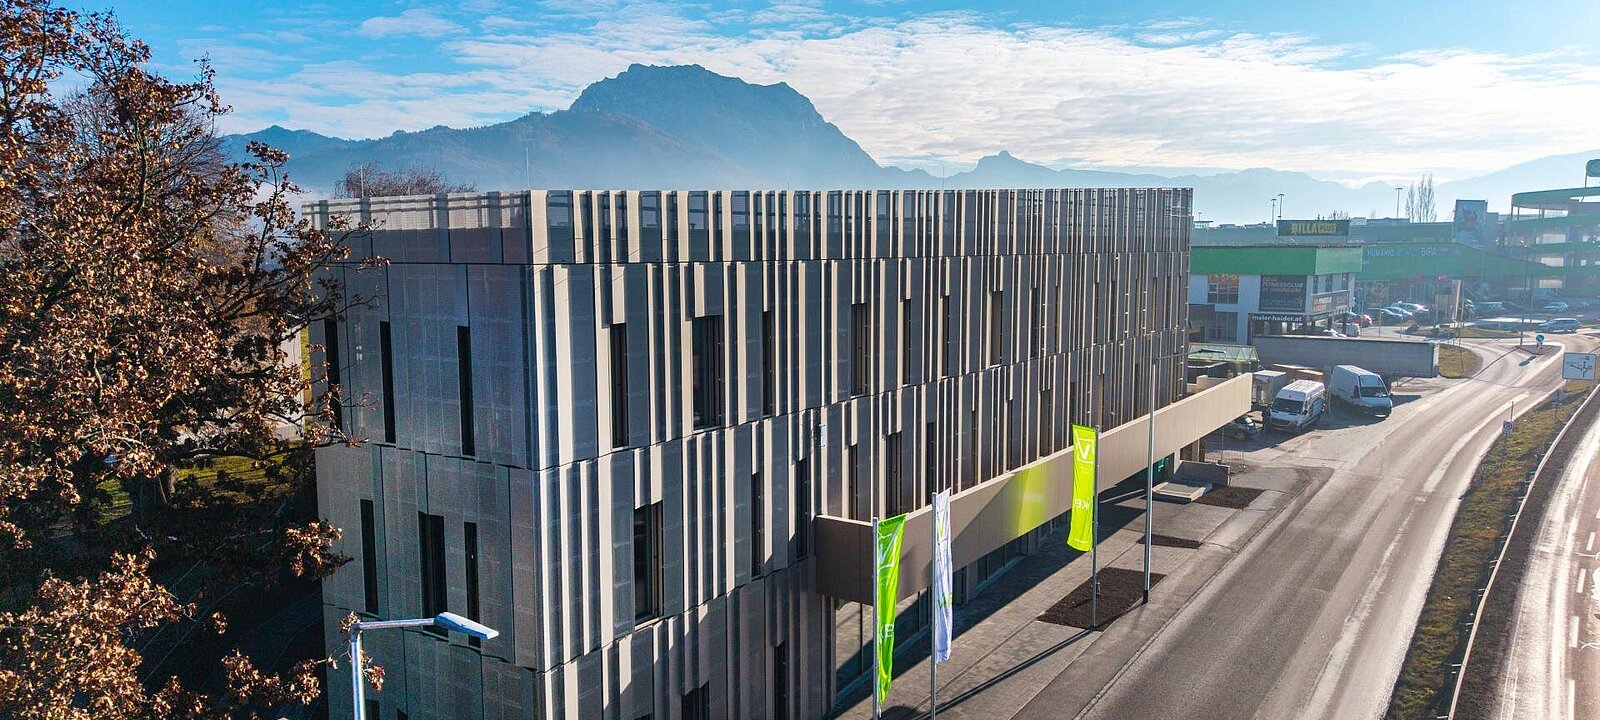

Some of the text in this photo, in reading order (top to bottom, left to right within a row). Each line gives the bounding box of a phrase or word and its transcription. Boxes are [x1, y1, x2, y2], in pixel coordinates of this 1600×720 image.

[1291, 222, 1318, 234] BILLA
[1366, 248, 1395, 257] HUMANIC
[1251, 314, 1302, 322] maler-haider.at
